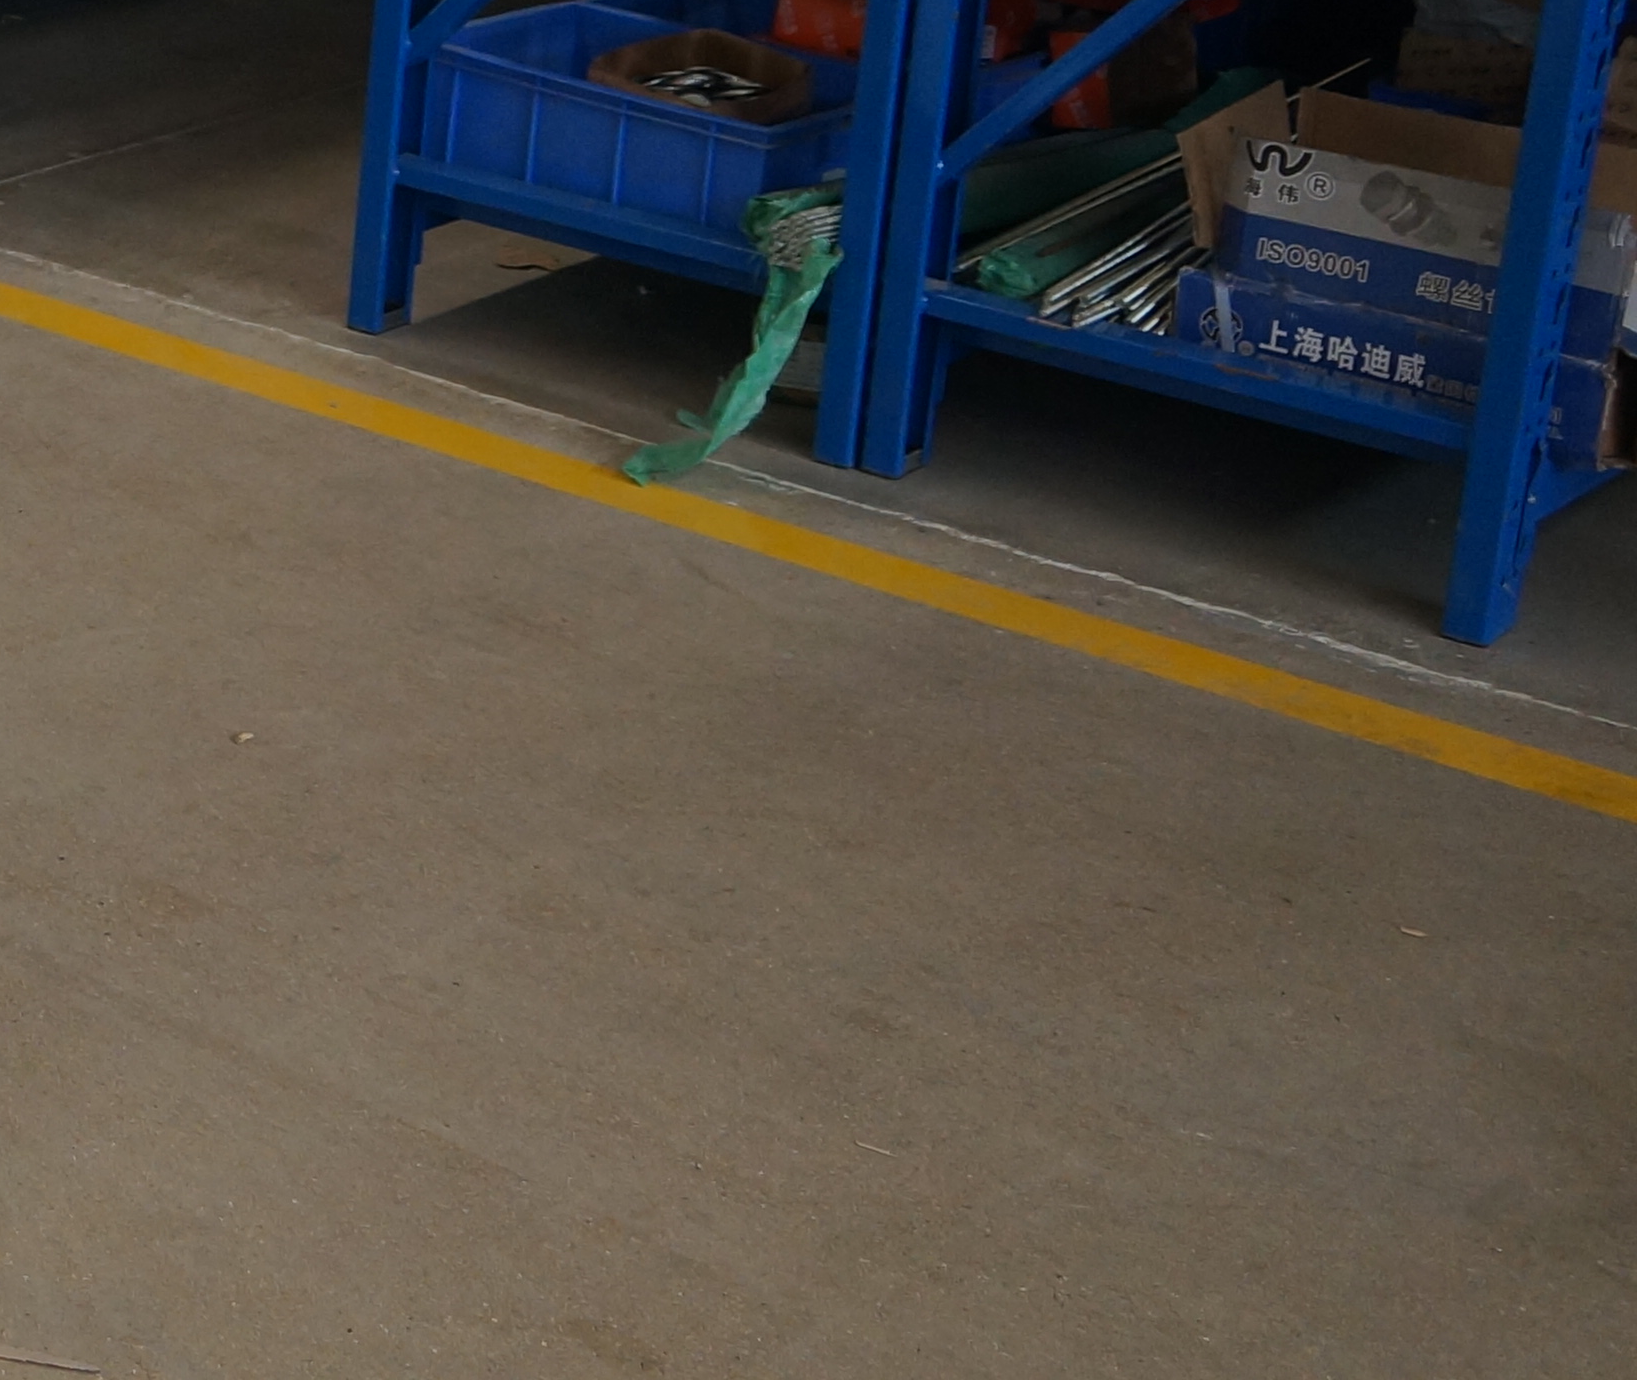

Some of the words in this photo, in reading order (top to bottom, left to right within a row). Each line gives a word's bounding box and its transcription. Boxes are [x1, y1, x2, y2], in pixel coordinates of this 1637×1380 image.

[1256, 237, 1369, 283] ISO9001
[1258, 320, 1427, 389] 上海哈迪威
